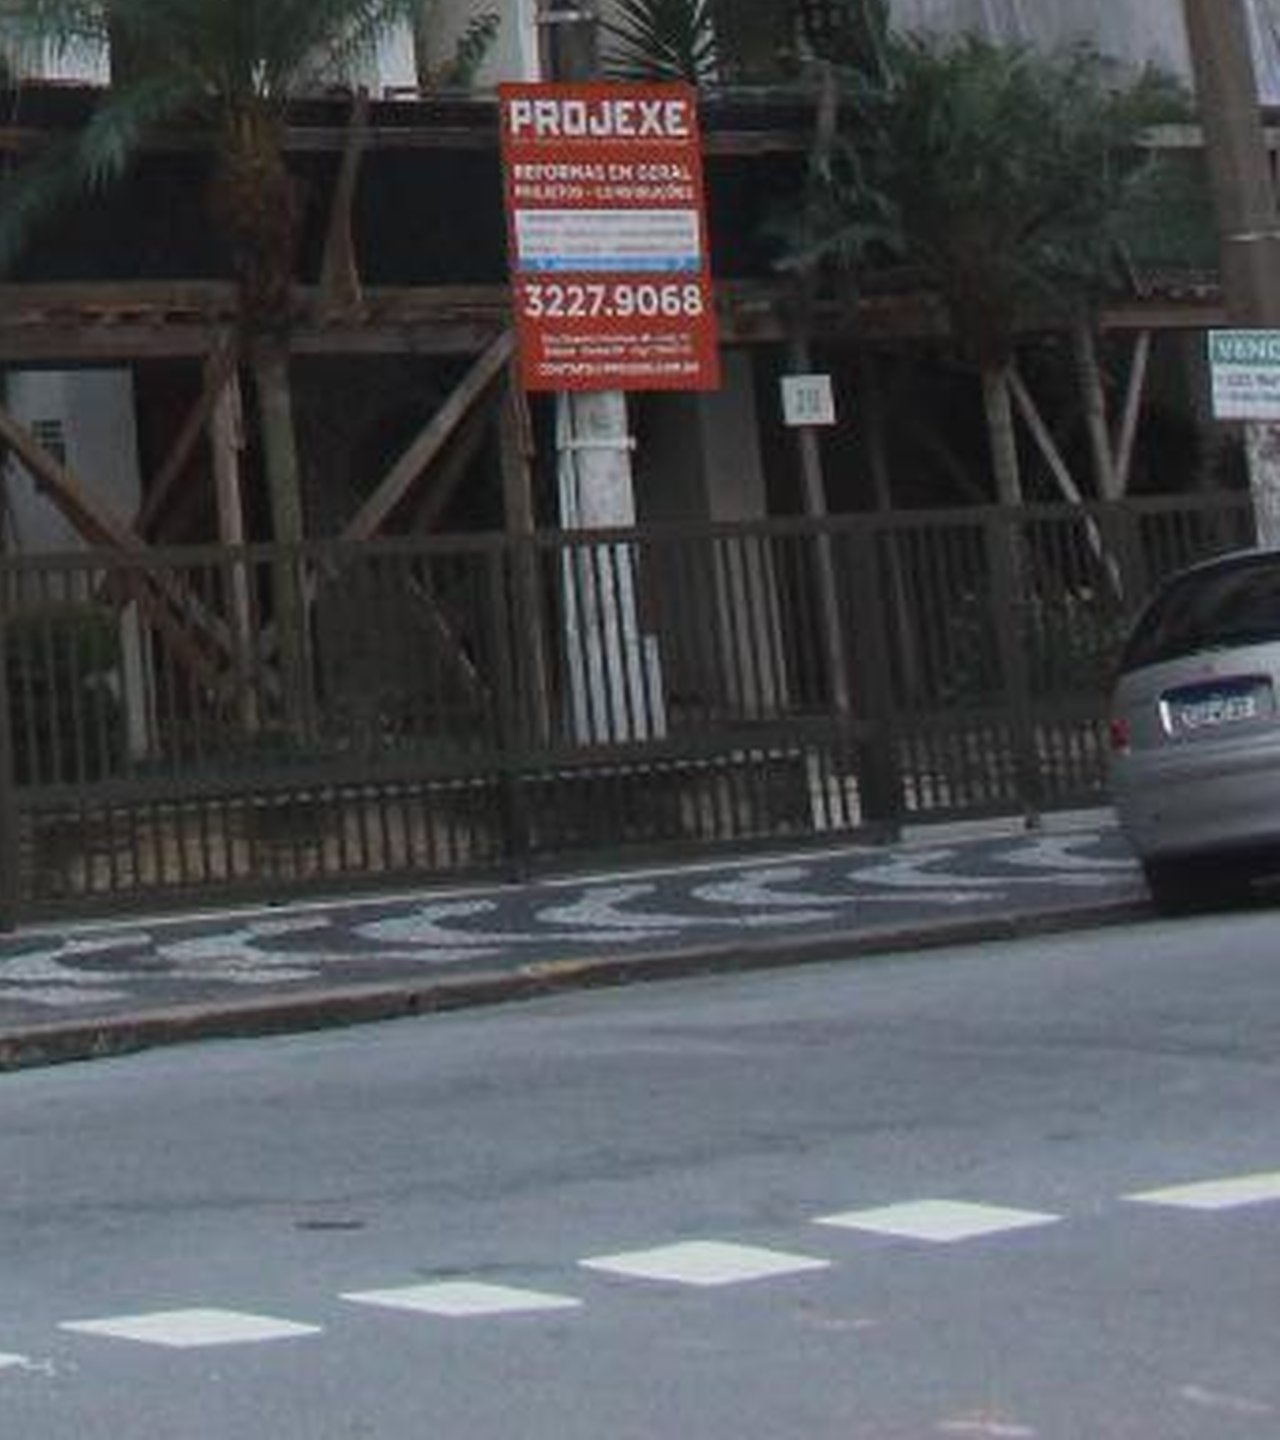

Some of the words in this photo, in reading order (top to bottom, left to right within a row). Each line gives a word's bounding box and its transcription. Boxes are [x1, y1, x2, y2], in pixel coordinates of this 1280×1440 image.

[509, 99, 689, 136] PROJEXE
[513, 163, 605, 181] REFORMAS
[608, 164, 633, 181] EM
[635, 164, 692, 181] GERAL
[524, 282, 703, 317] 3227.9068
